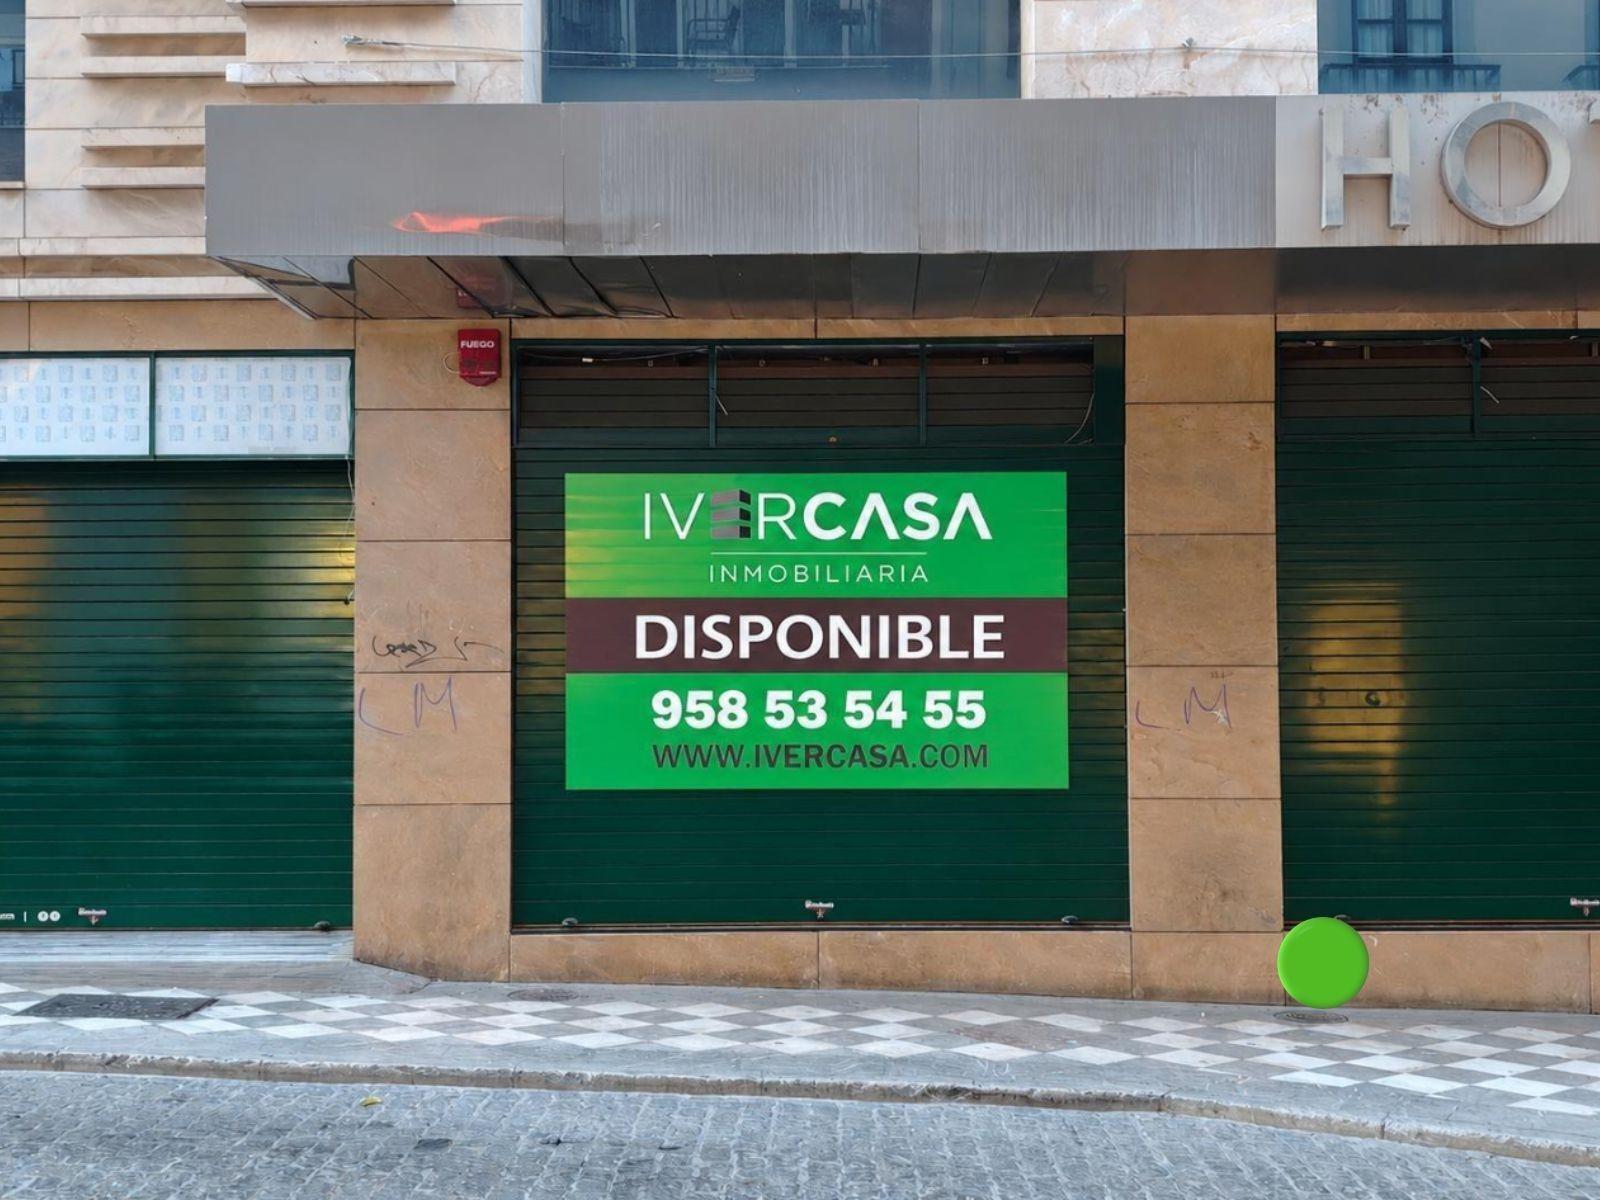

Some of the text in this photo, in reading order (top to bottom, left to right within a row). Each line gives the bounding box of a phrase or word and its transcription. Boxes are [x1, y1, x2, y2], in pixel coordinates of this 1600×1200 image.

[1320, 100, 1600, 230] HO
[460, 340, 495, 349] FUEGO
[643, 489, 992, 541] IVERCASA
[709, 564, 929, 583] INMOBILIARIA
[635, 614, 1005, 660] DISPONIBLE
[651, 689, 987, 730] 958 53 54 55
[652, 743, 989, 769] WWW.IVERCASA.COM
